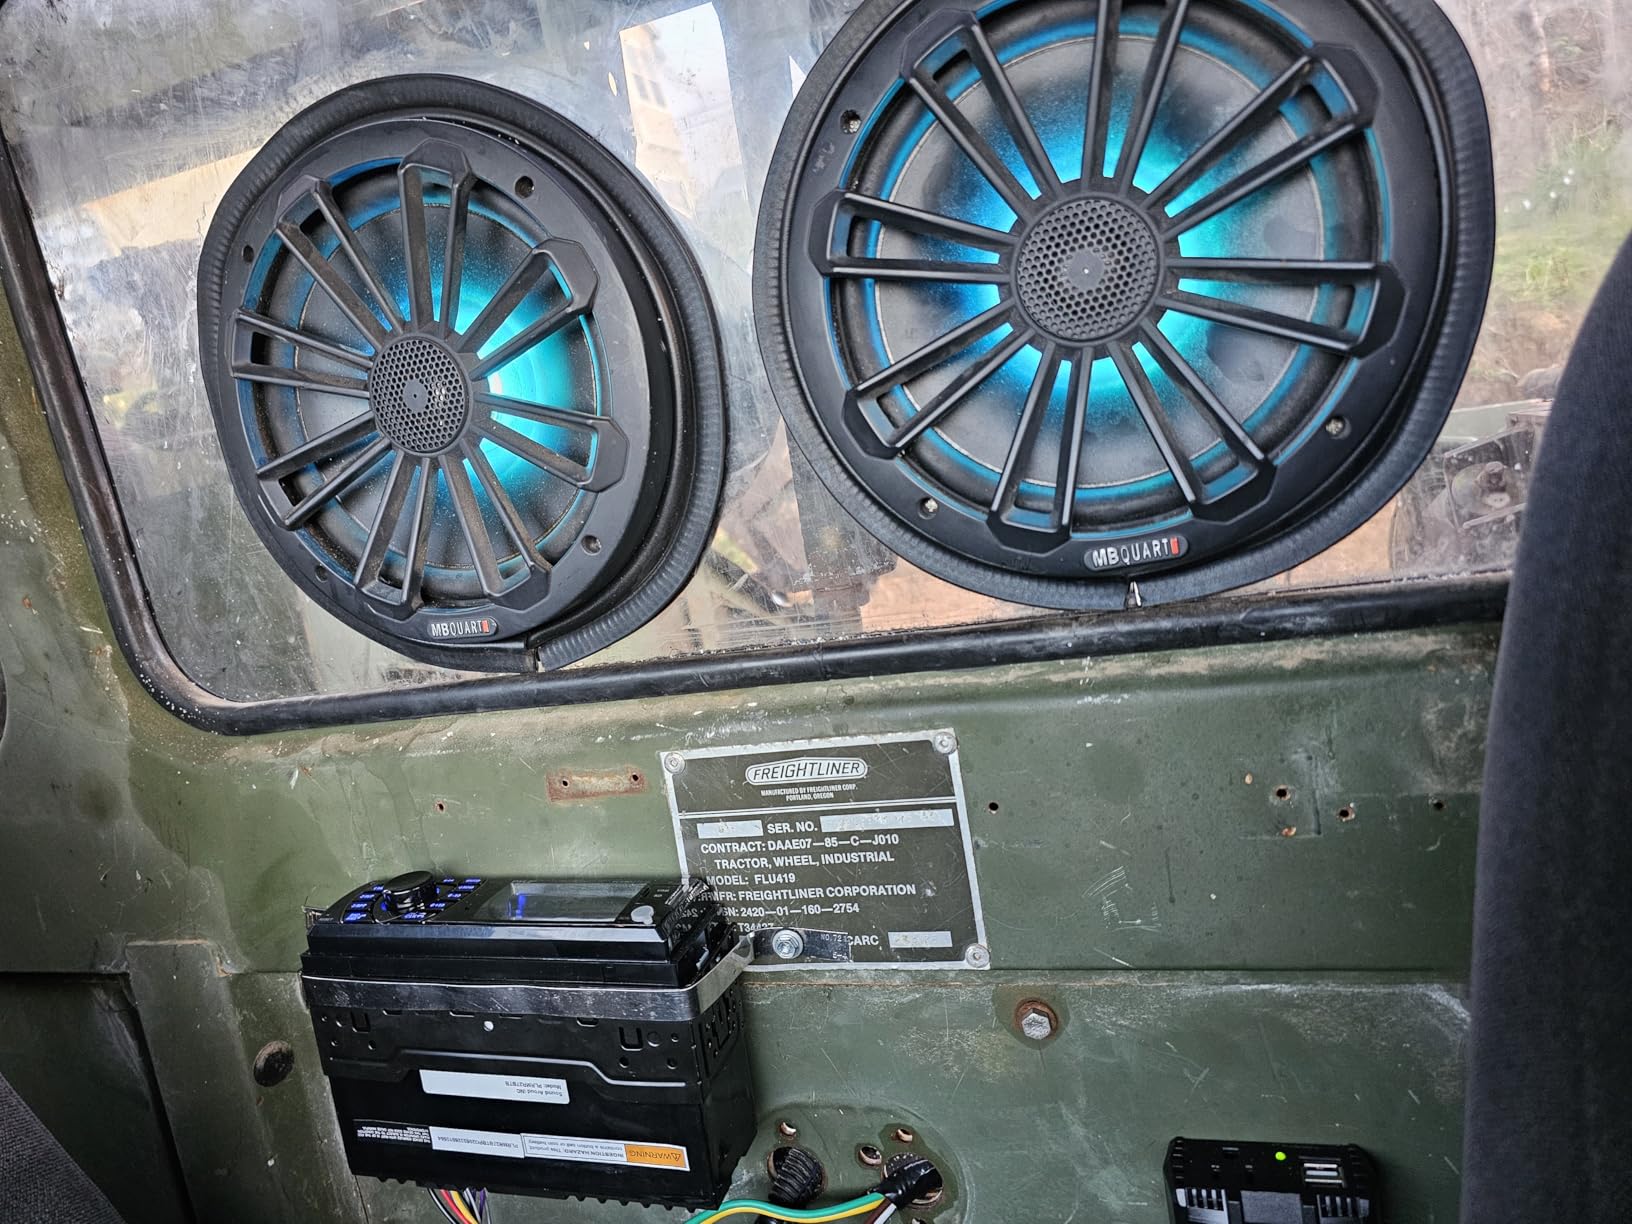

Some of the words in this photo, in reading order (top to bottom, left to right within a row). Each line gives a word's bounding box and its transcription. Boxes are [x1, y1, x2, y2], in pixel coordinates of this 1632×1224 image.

[753, 762, 860, 780] FREIGHTLINER
[760, 787, 799, 796] MANUFACTURED
[807, 784, 842, 793] FREIGHTLINER
[767, 822, 794, 834] SER.
[796, 821, 818, 832] NO.
[701, 841, 766, 854] CONTRACT:
[714, 857, 772, 869] TRACTOR,
[773, 855, 819, 867] WHEEL,
[821, 851, 895, 864] INDUSTRIAL
[706, 875, 749, 885] MODEL:
[754, 873, 796, 884] FLU419
[738, 888, 825, 901] FREIGHTLINER
[826, 884, 916, 897] CORPORATION
[629, 1150, 671, 1159] WARNING
